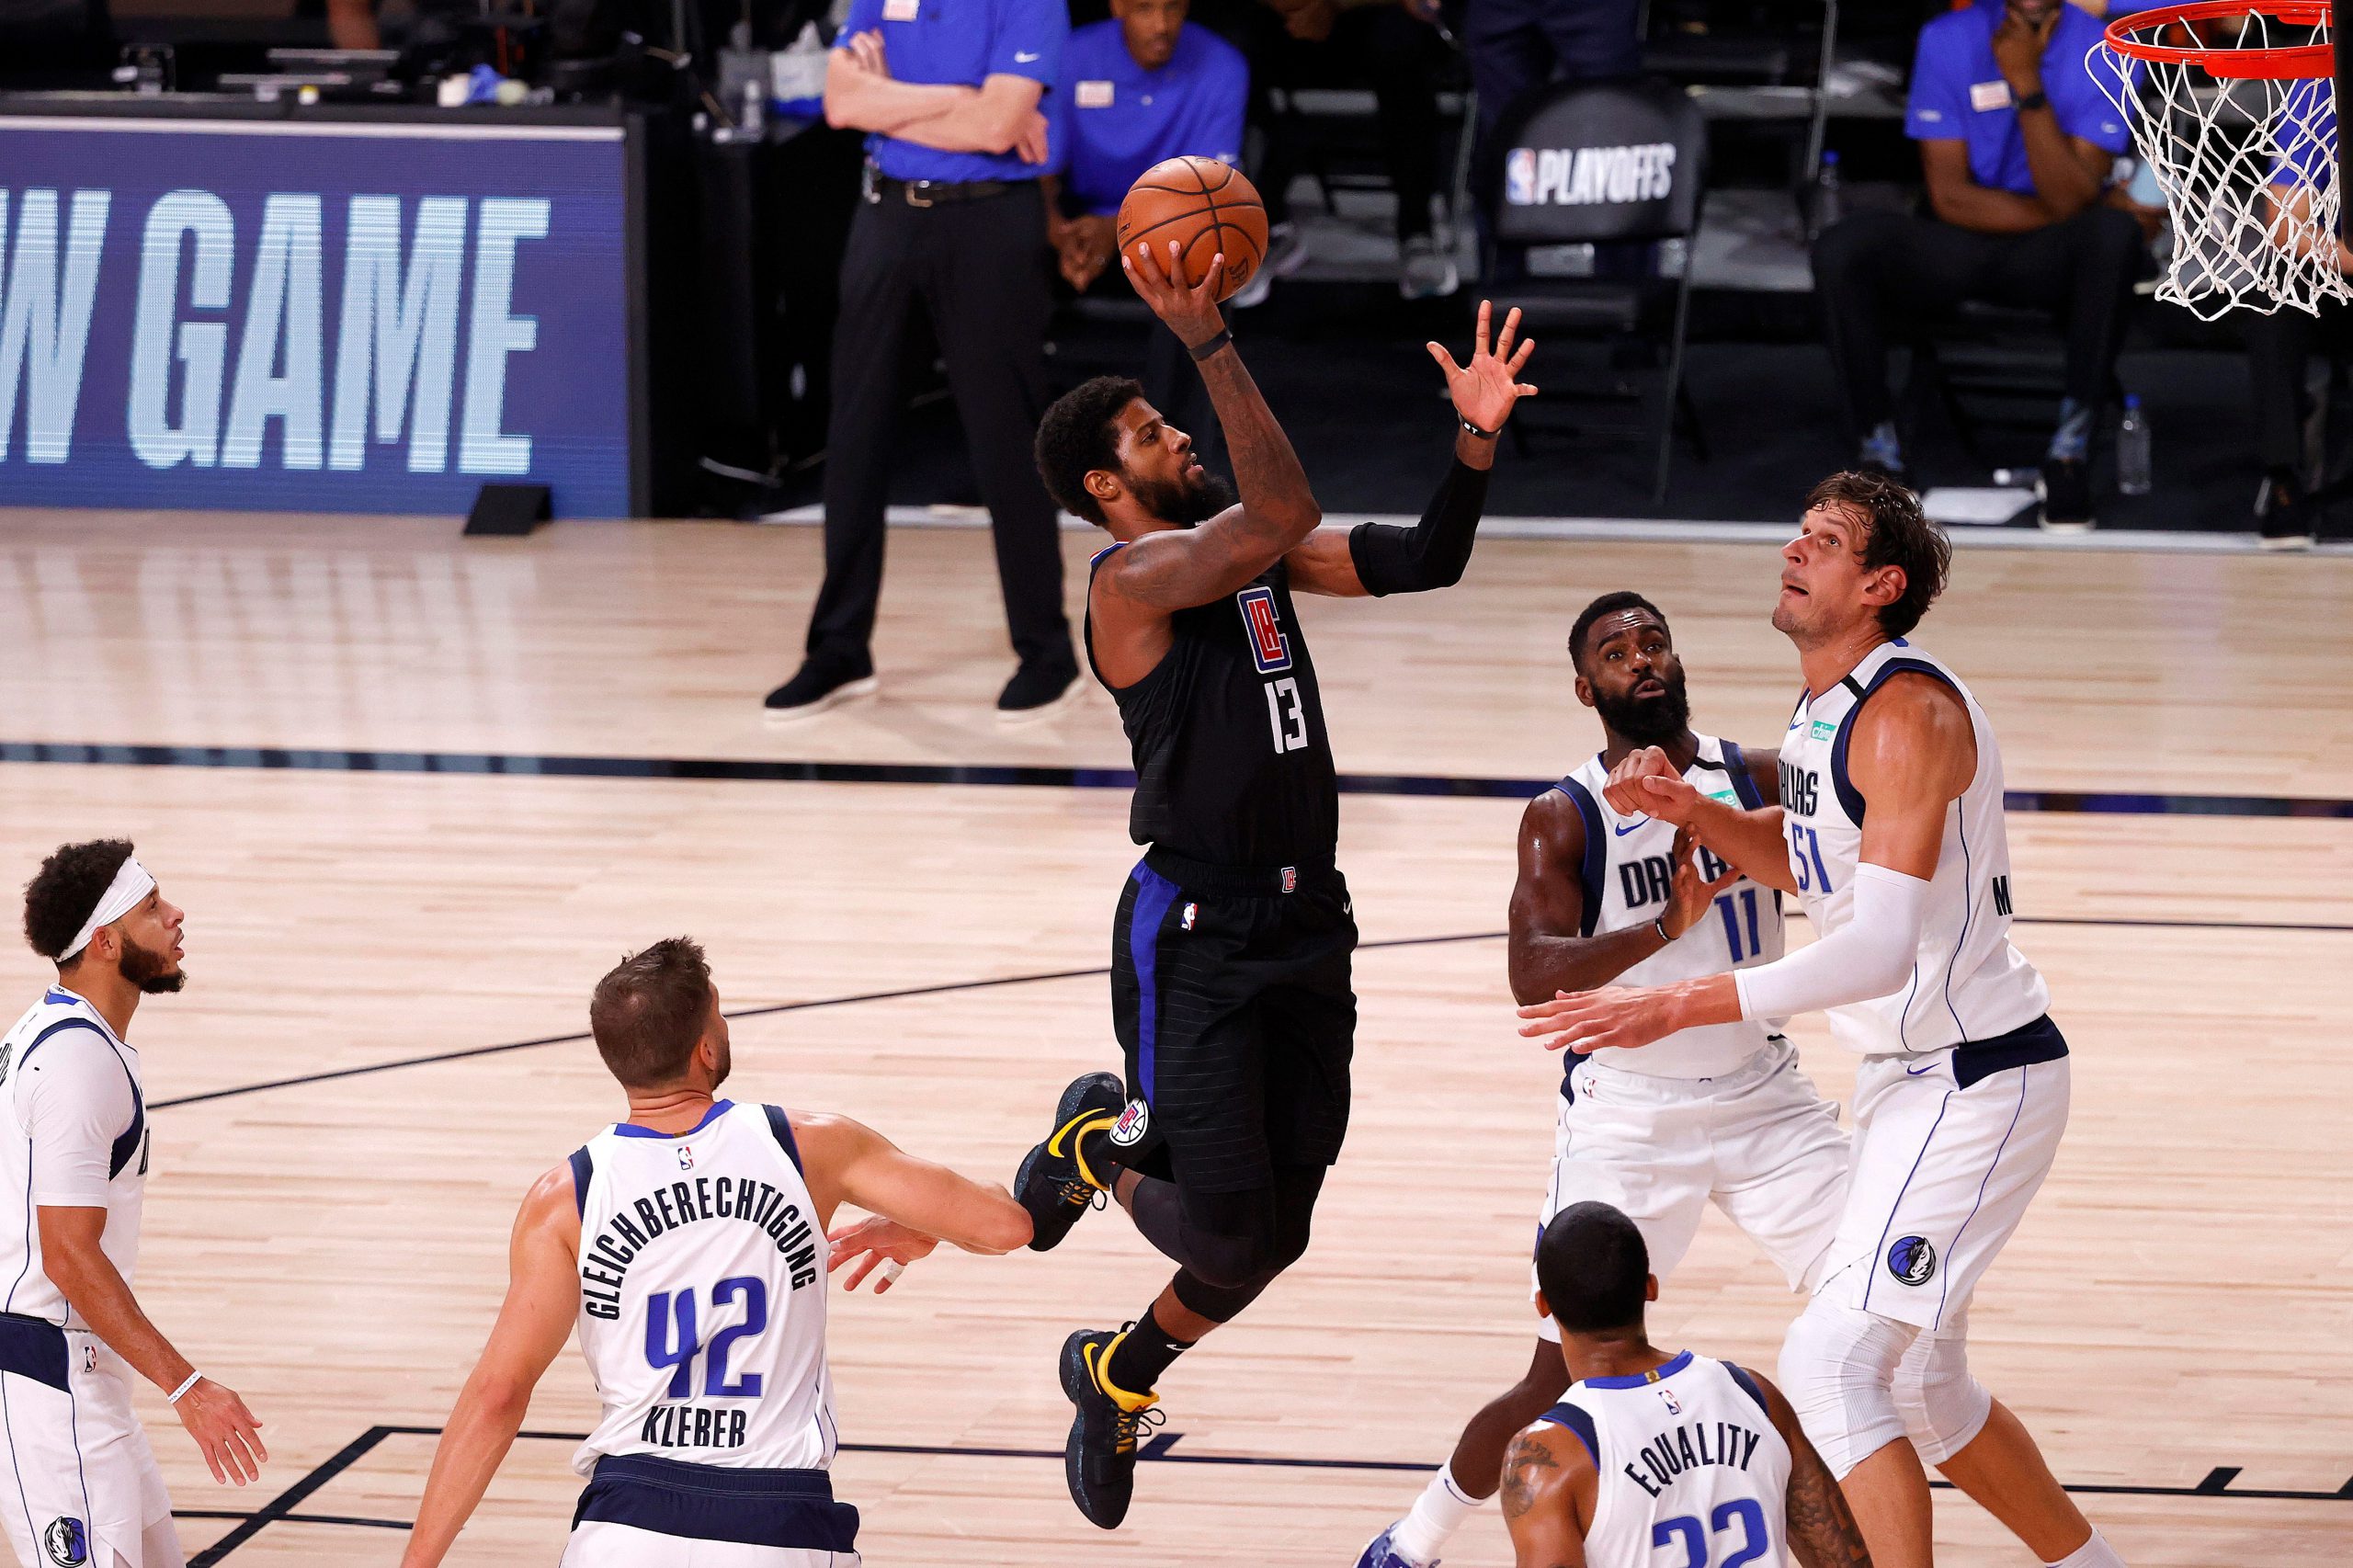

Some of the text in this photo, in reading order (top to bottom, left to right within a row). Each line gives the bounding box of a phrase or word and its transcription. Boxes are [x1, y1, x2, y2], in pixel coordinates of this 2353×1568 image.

[1537, 142, 1677, 205] PLAYOFFS
[127, 189, 551, 474] GAME
[1264, 676, 1308, 755] 13
[1791, 821, 1834, 895] 51
[1714, 889, 1761, 964] 11
[582, 1176, 817, 1321] GLEICHBERECHTIGUNG
[643, 1274, 769, 1400] 42
[641, 1405, 747, 1449] KLEBER
[1624, 1422, 1761, 1499] EQUALITY
